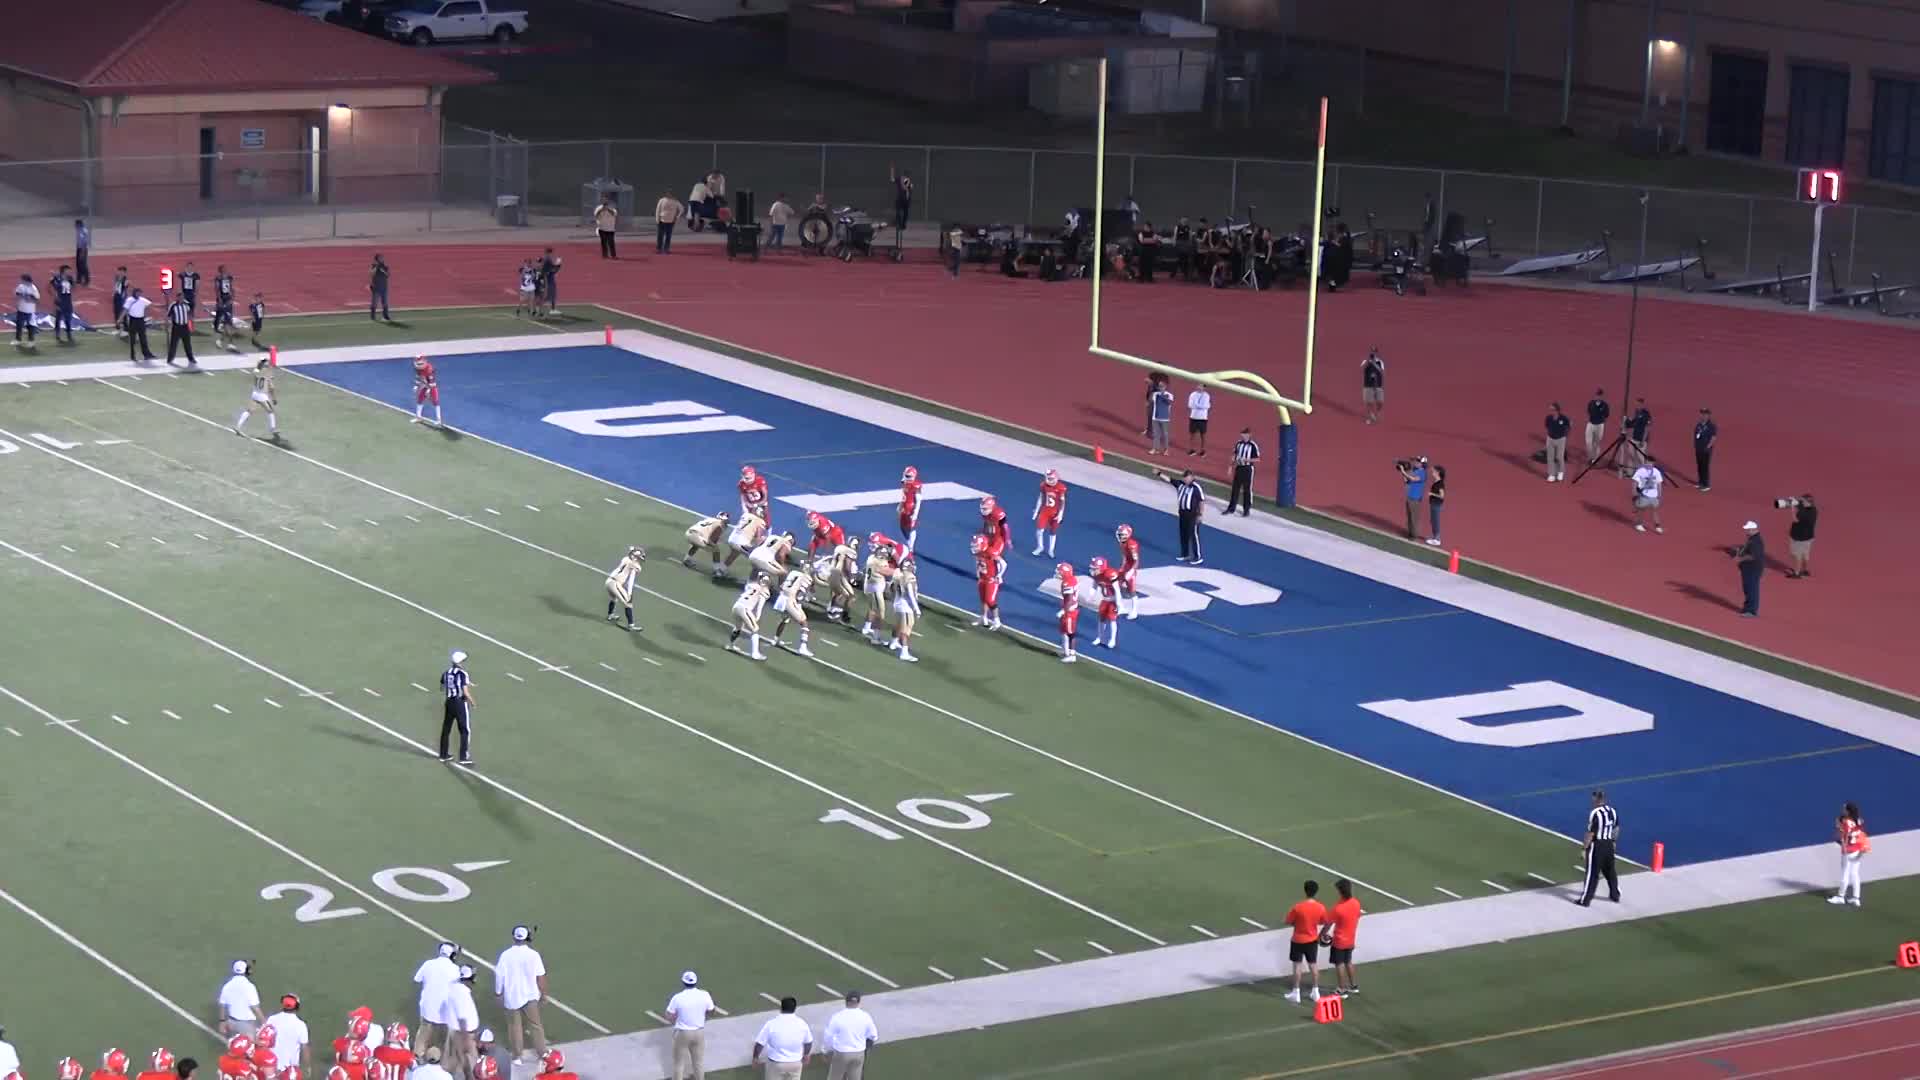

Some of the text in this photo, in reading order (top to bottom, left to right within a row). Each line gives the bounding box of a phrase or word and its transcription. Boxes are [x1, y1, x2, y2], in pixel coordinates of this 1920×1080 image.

[1810, 171, 1839, 201] 17
[161, 269, 173, 290] 3
[818, 798, 992, 841] 10
[260, 865, 472, 923] 20
[1906, 945, 1917, 964] G
[1322, 999, 1340, 1020] 10
